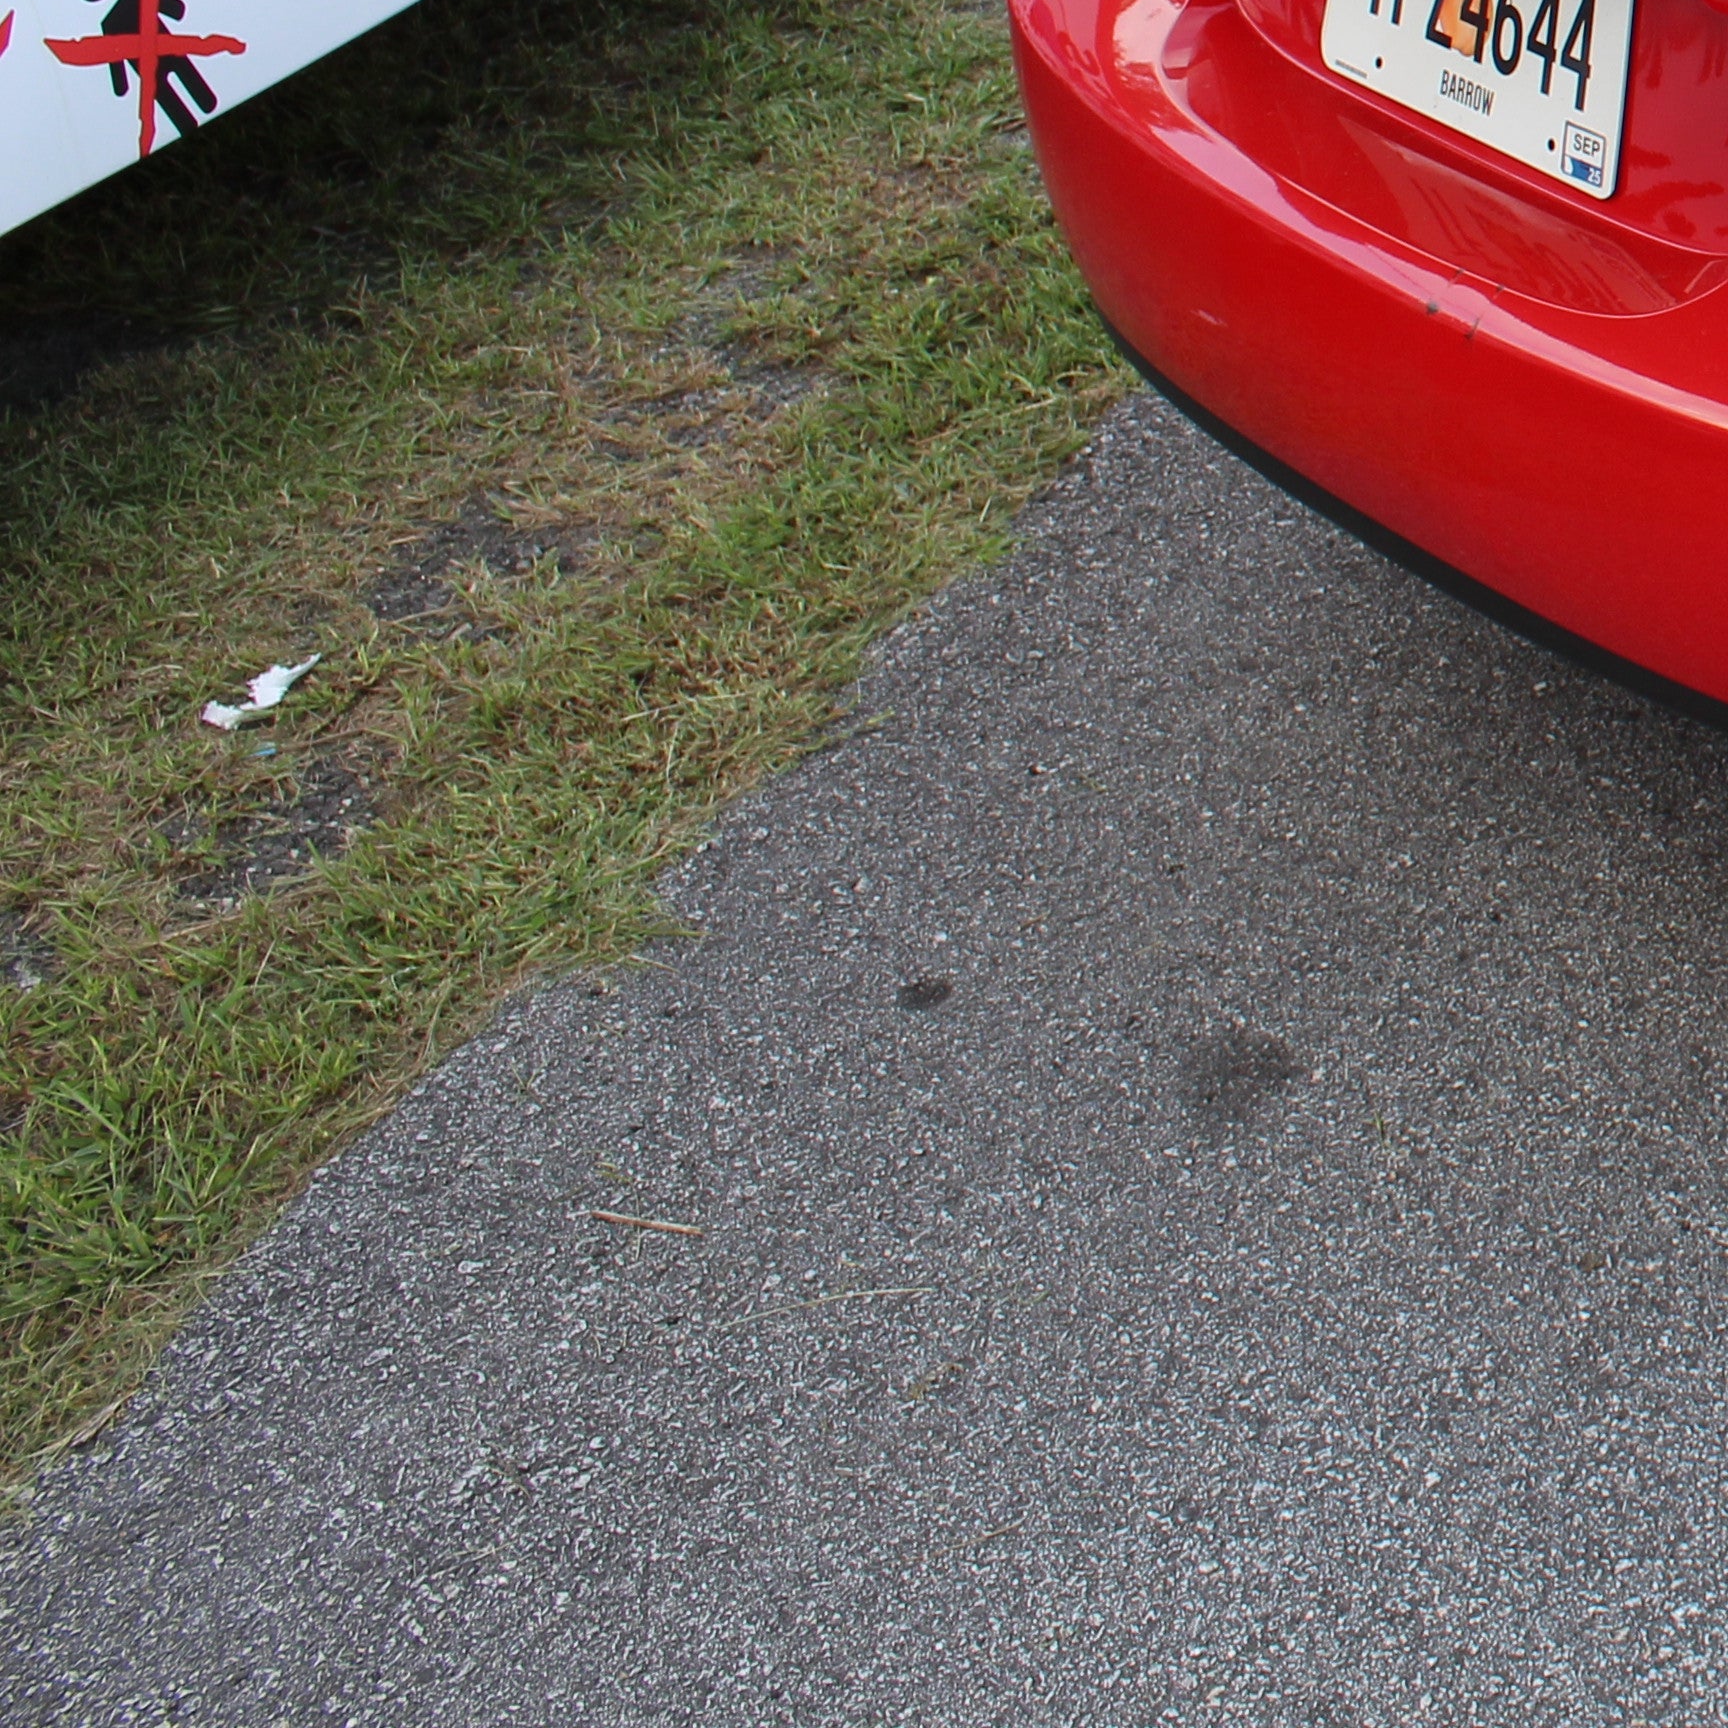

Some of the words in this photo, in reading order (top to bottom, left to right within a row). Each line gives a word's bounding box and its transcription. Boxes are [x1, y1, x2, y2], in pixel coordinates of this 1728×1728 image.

[1439, 69, 1495, 116] BARROW
[1573, 133, 1601, 157] SEP
[1587, 166, 1601, 185] 25
